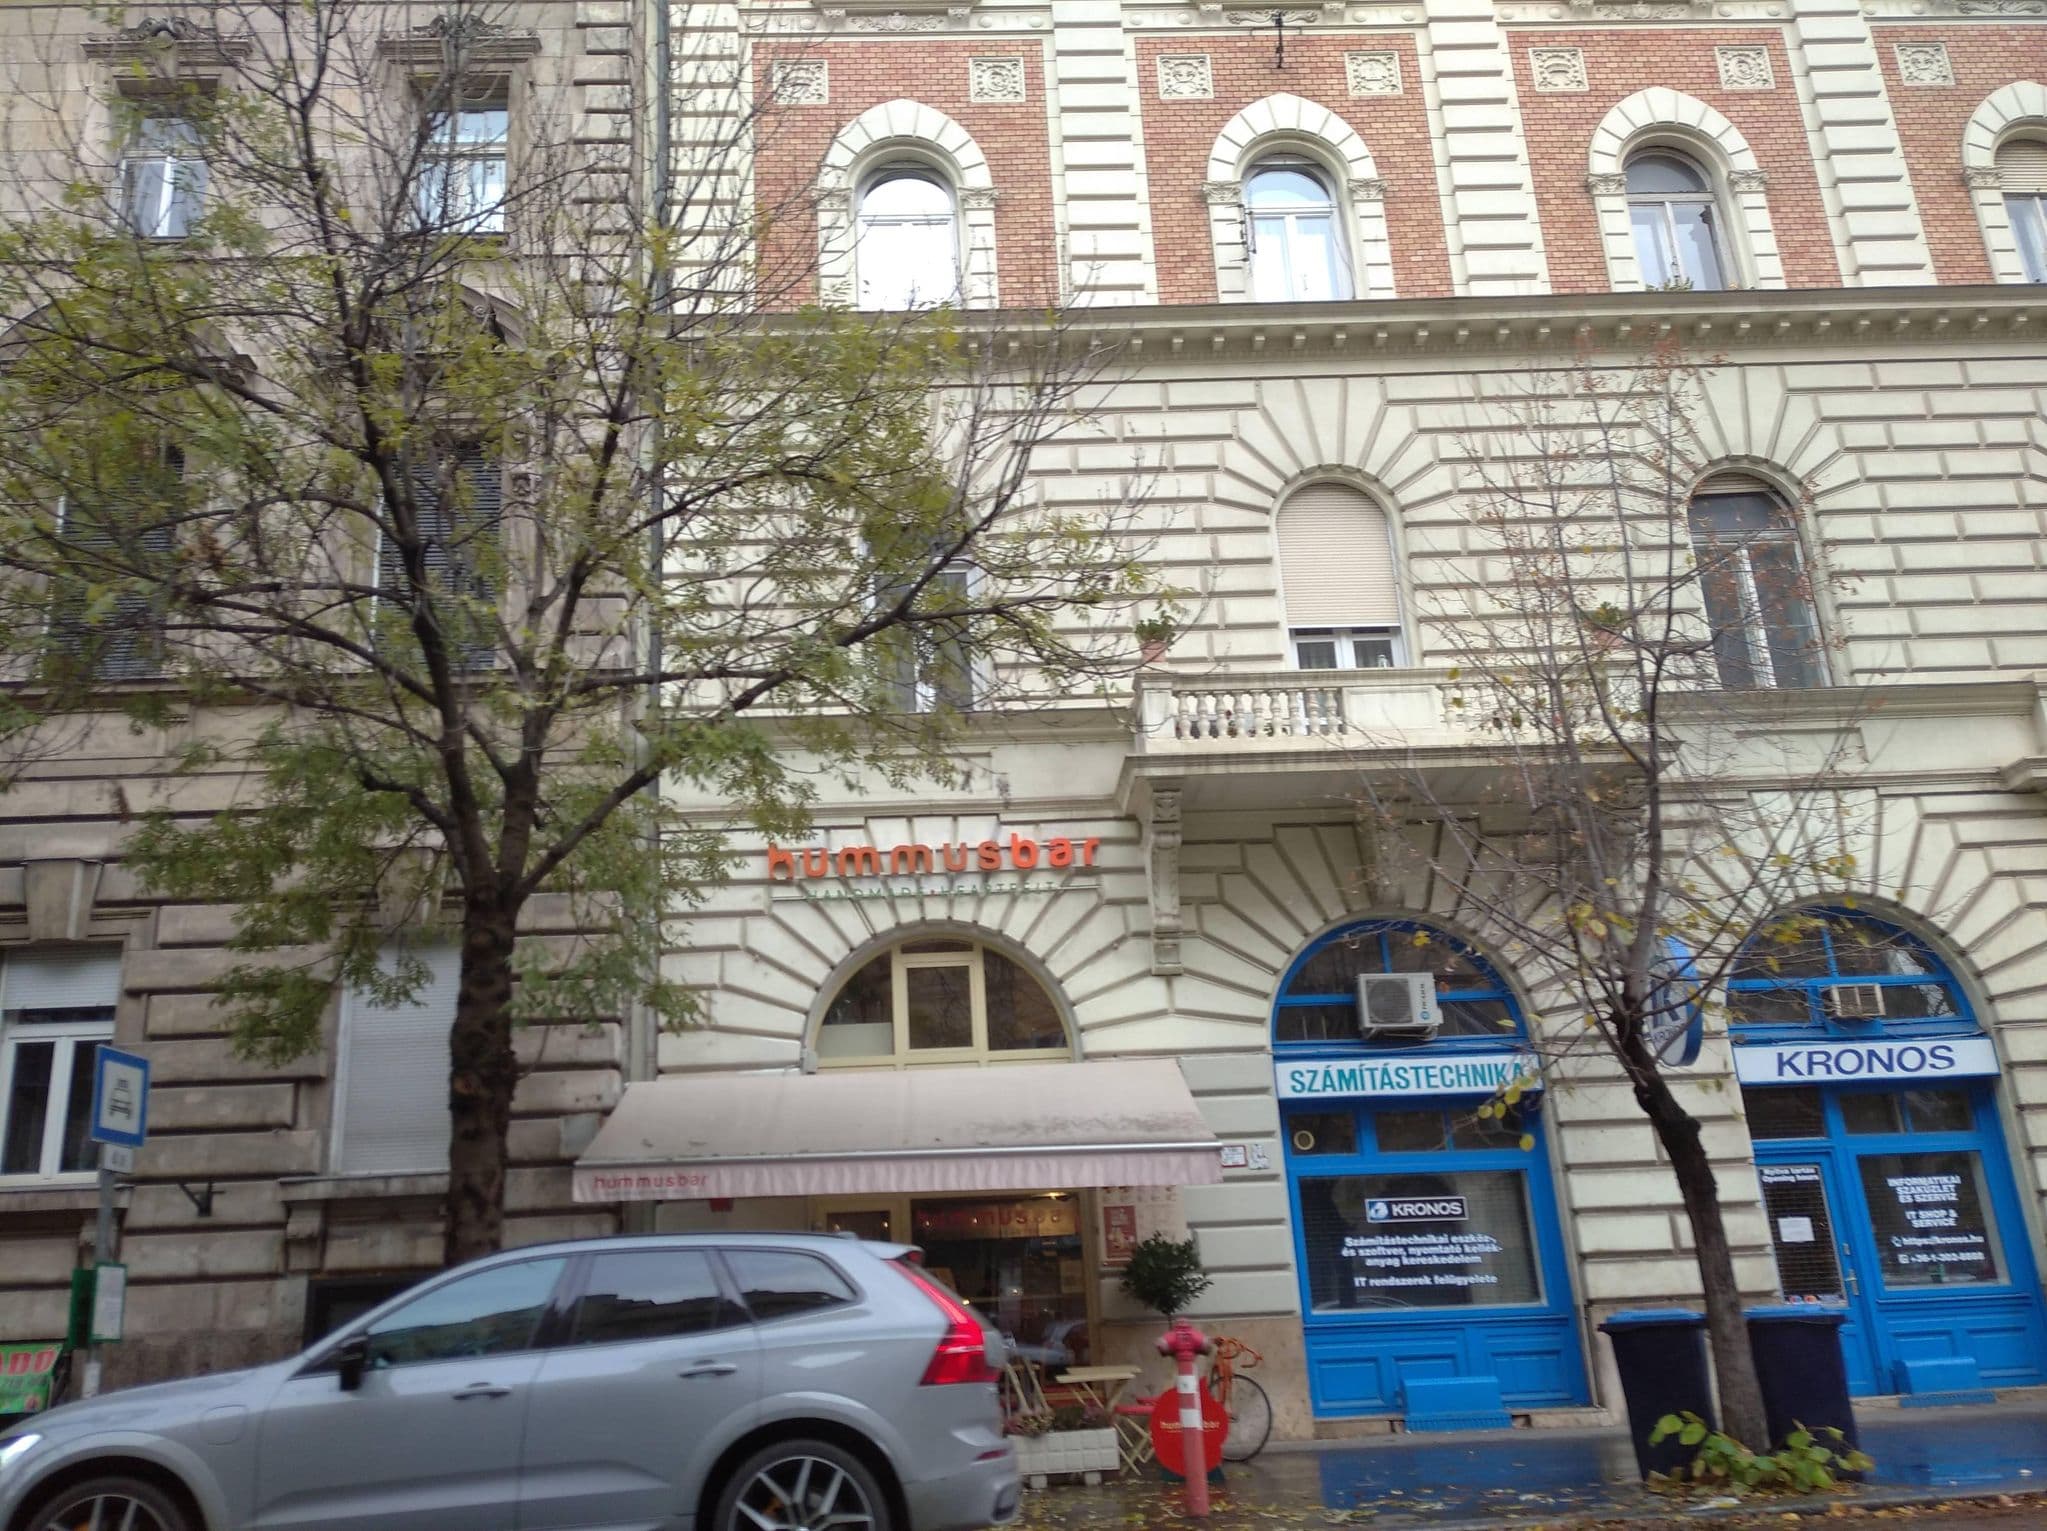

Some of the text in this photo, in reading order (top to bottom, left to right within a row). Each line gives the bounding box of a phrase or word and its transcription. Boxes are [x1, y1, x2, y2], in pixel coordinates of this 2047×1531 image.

[767, 832, 1101, 880] hummusbar
[807, 886, 924, 899] HANDMADE
[1776, 1044, 1956, 1077] KRONOS
[1290, 1061, 1525, 1094] SZÁMÍTÁSTECHNIKA
[592, 1173, 708, 1190] hummusbar
[1392, 1202, 1462, 1217] KRONOS
[1918, 1209, 1947, 1219] SHOP
[1911, 1218, 1957, 1228] SERVICE
[1344, 1234, 1449, 1247] Számítástechnikai
[1365, 1255, 1482, 1268] anyag kereskedelem
[1354, 1274, 1498, 1287] IT rendszerek felügyelete
